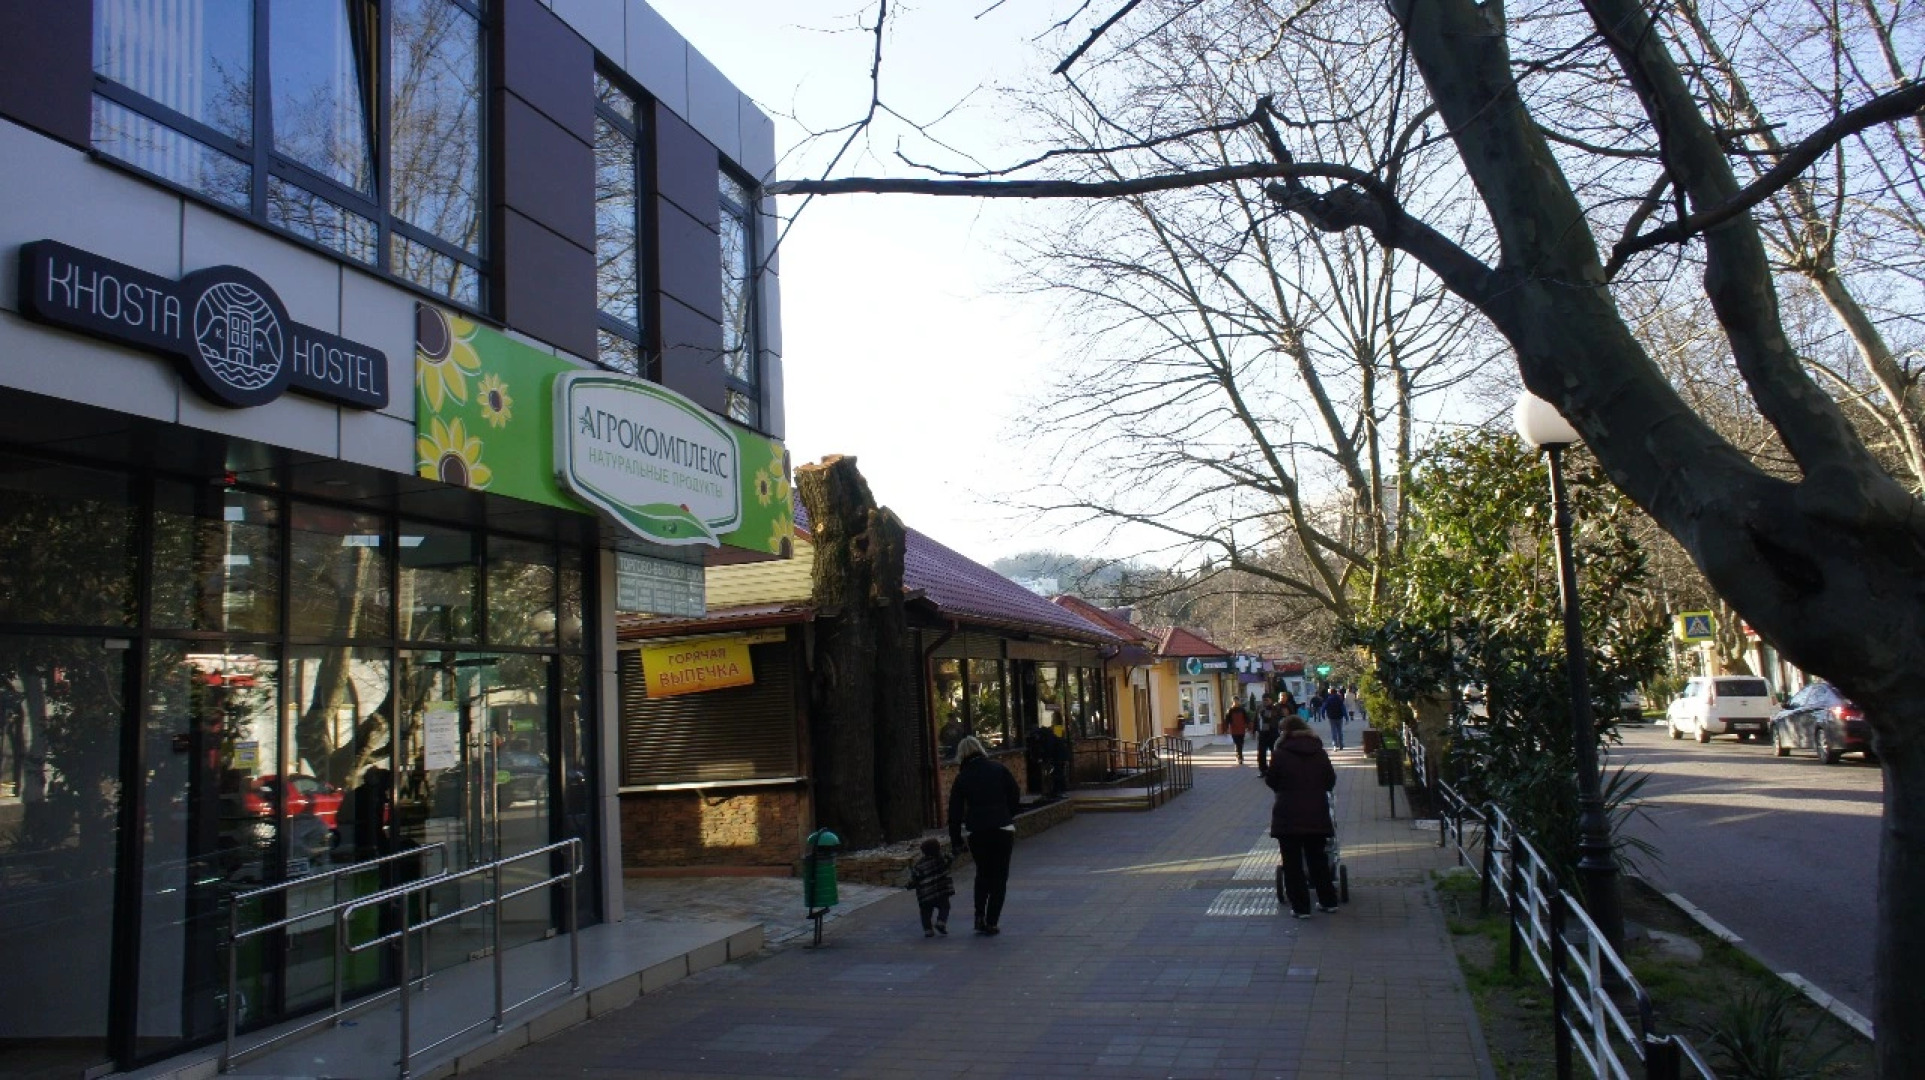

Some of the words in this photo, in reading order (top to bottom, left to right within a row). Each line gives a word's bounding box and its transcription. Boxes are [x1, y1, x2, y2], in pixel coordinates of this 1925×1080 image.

[48, 257, 181, 339] KHOSTA
[293, 335, 380, 396] HOSTEL
[579, 405, 728, 479] АГРОКОМПЛЕКС
[589, 446, 669, 484] НАТУРАЛЬНЫЕ
[673, 471, 723, 499] ПРОДУКТЫ
[659, 662, 740, 687] ВЫПЕЧКА
[668, 647, 726, 665] ГОРЯЧАЯ
